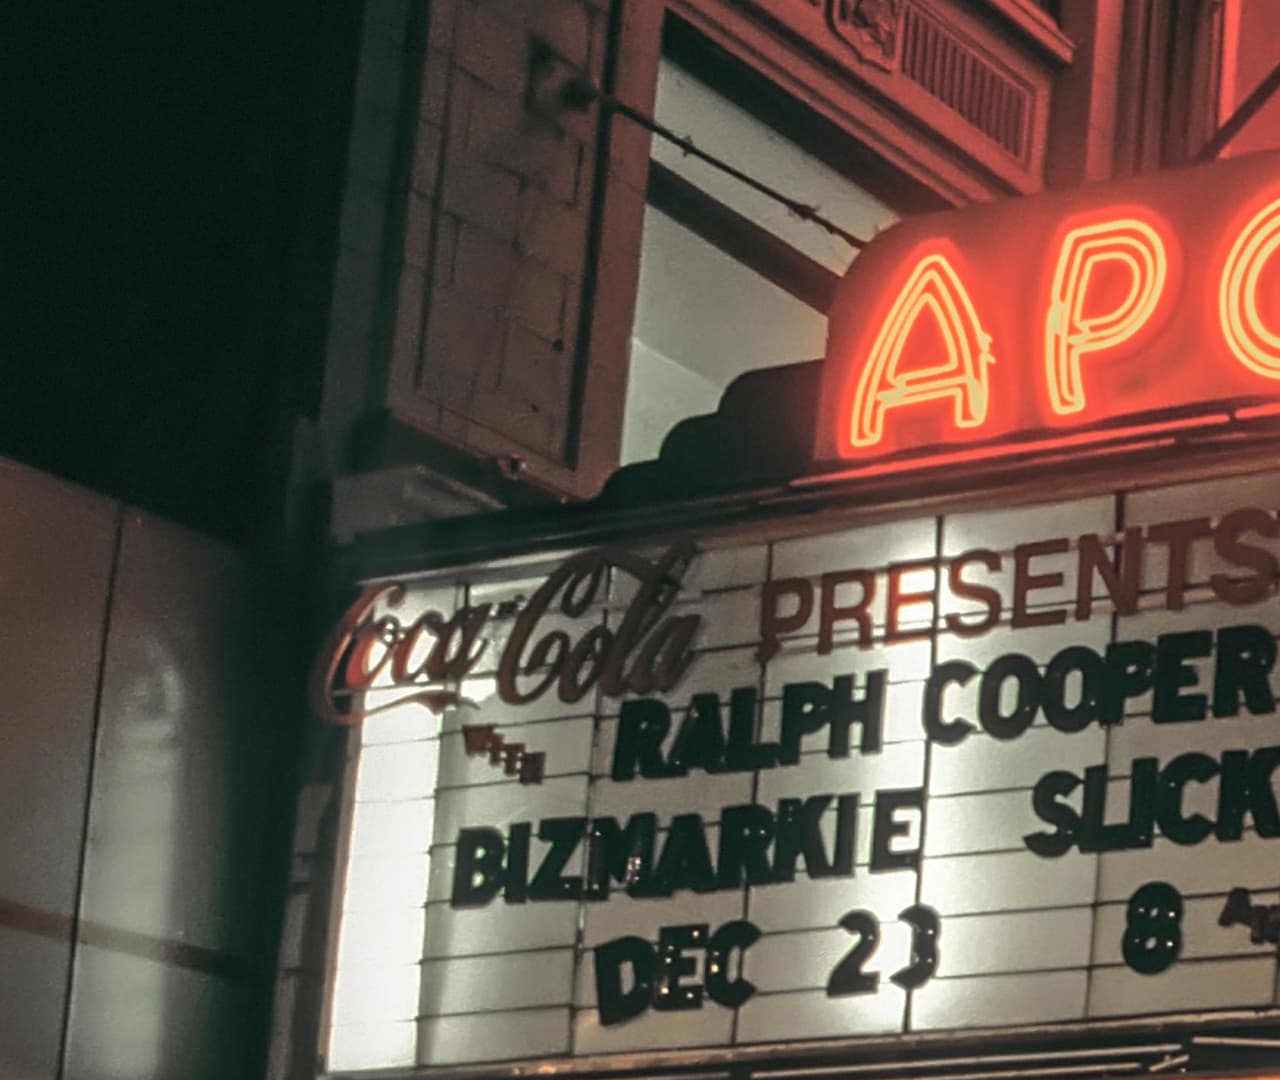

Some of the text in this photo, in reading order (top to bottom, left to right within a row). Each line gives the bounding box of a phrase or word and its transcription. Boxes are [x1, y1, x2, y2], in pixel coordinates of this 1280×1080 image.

[757, 508, 1280, 656] PRESENTS
[612, 668, 888, 781] RALPH
[923, 625, 1277, 746] COOPER
[595, 920, 761, 1025] DEC
[827, 905, 942, 997] 23
[1122, 882, 1183, 975] 8
